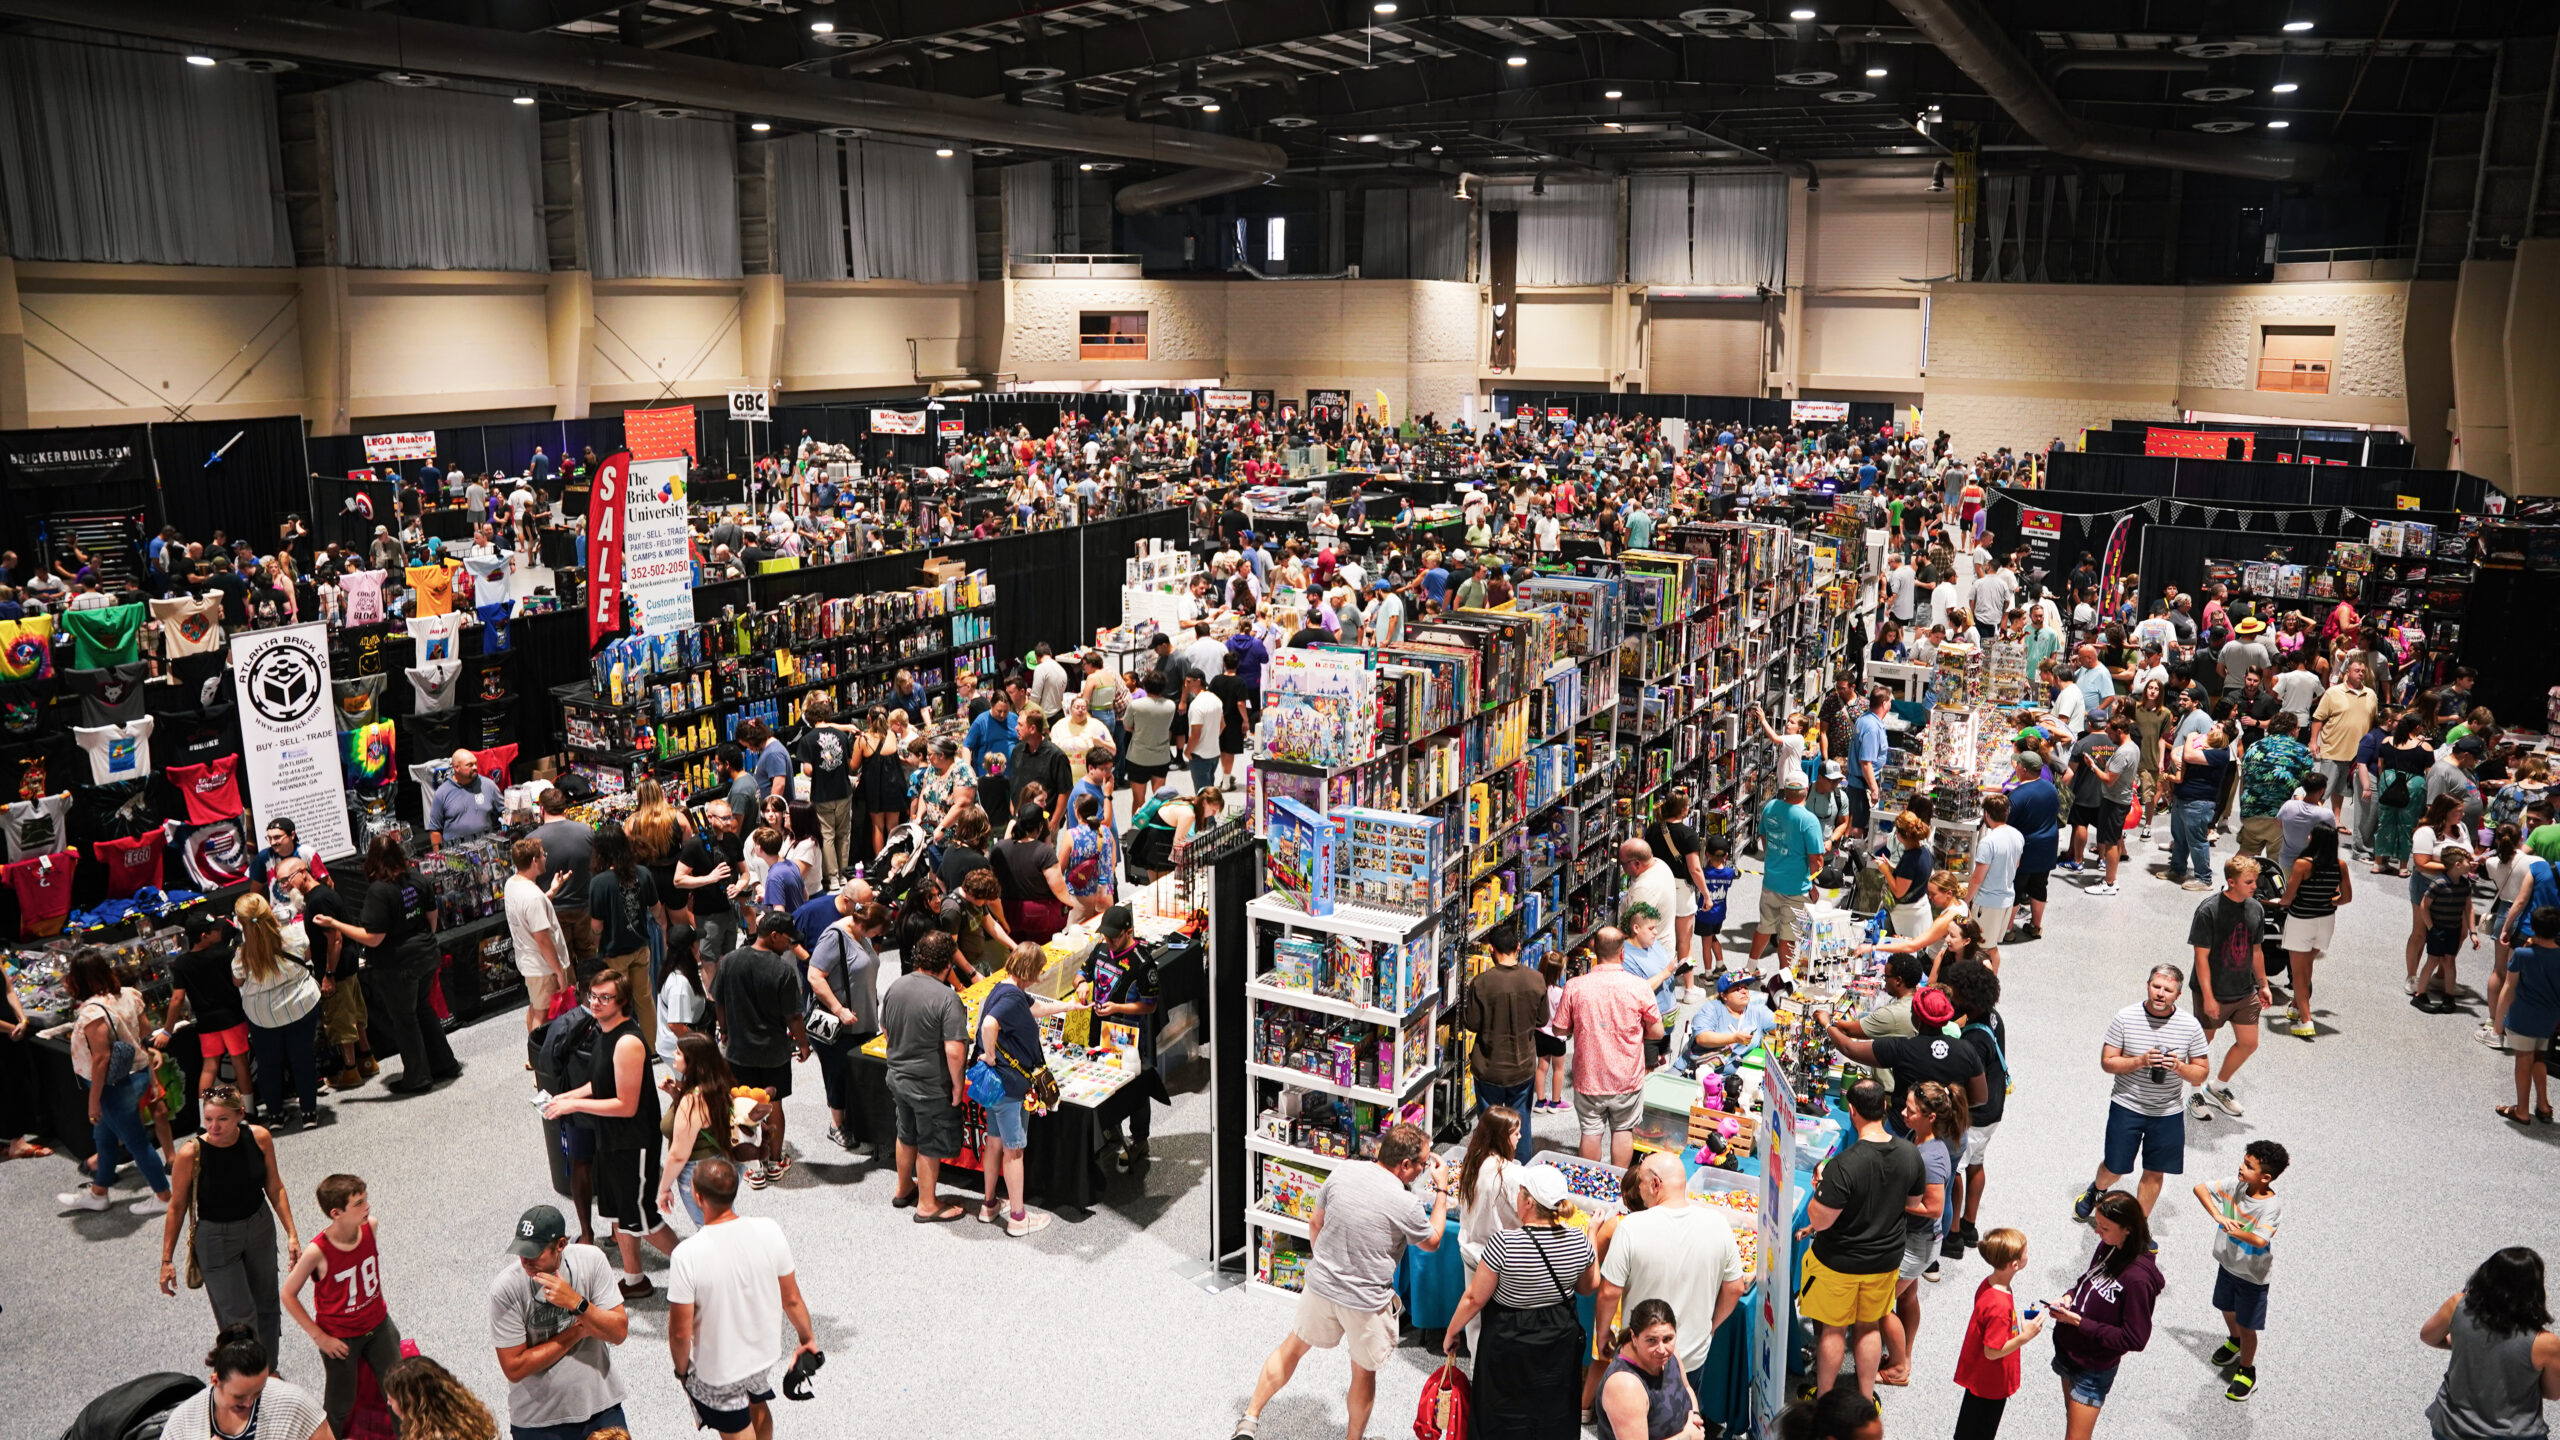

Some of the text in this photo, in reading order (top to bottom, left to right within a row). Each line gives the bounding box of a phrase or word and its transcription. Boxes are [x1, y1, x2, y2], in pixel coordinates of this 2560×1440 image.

[733, 394, 765, 411] GBC
[366, 435, 431, 446] LEGO Masters
[10, 446, 132, 465] BRICKERBUILDS.COM
[628, 473, 648, 486] The
[627, 488, 657, 504] Brick
[628, 503, 685, 523] University
[628, 526, 686, 542] BUY SELL TRADE
[597, 466, 617, 623] SALE
[630, 537, 687, 551] PARTIES FIELD TRIPS
[632, 552, 656, 562] CAMPS
[631, 560, 689, 580] 352-502-2050
[646, 594, 691, 610] Custom Kits
[354, 611, 378, 620] BLOCK
[646, 612, 677, 626] Commission
[678, 608, 693, 620] Builds
[239, 636, 327, 684] ATLANTA BRICK CO
[255, 705, 322, 734] www.atlbrick.com
[256, 730, 333, 752] BUY SELL TRADE
[278, 757, 314, 770] @ATLBRICK
[279, 782, 308, 792] NEWNAN,
[125, 846, 151, 867] LEGO
[521, 1220, 534, 1236] TB
[334, 1255, 379, 1307] 78
